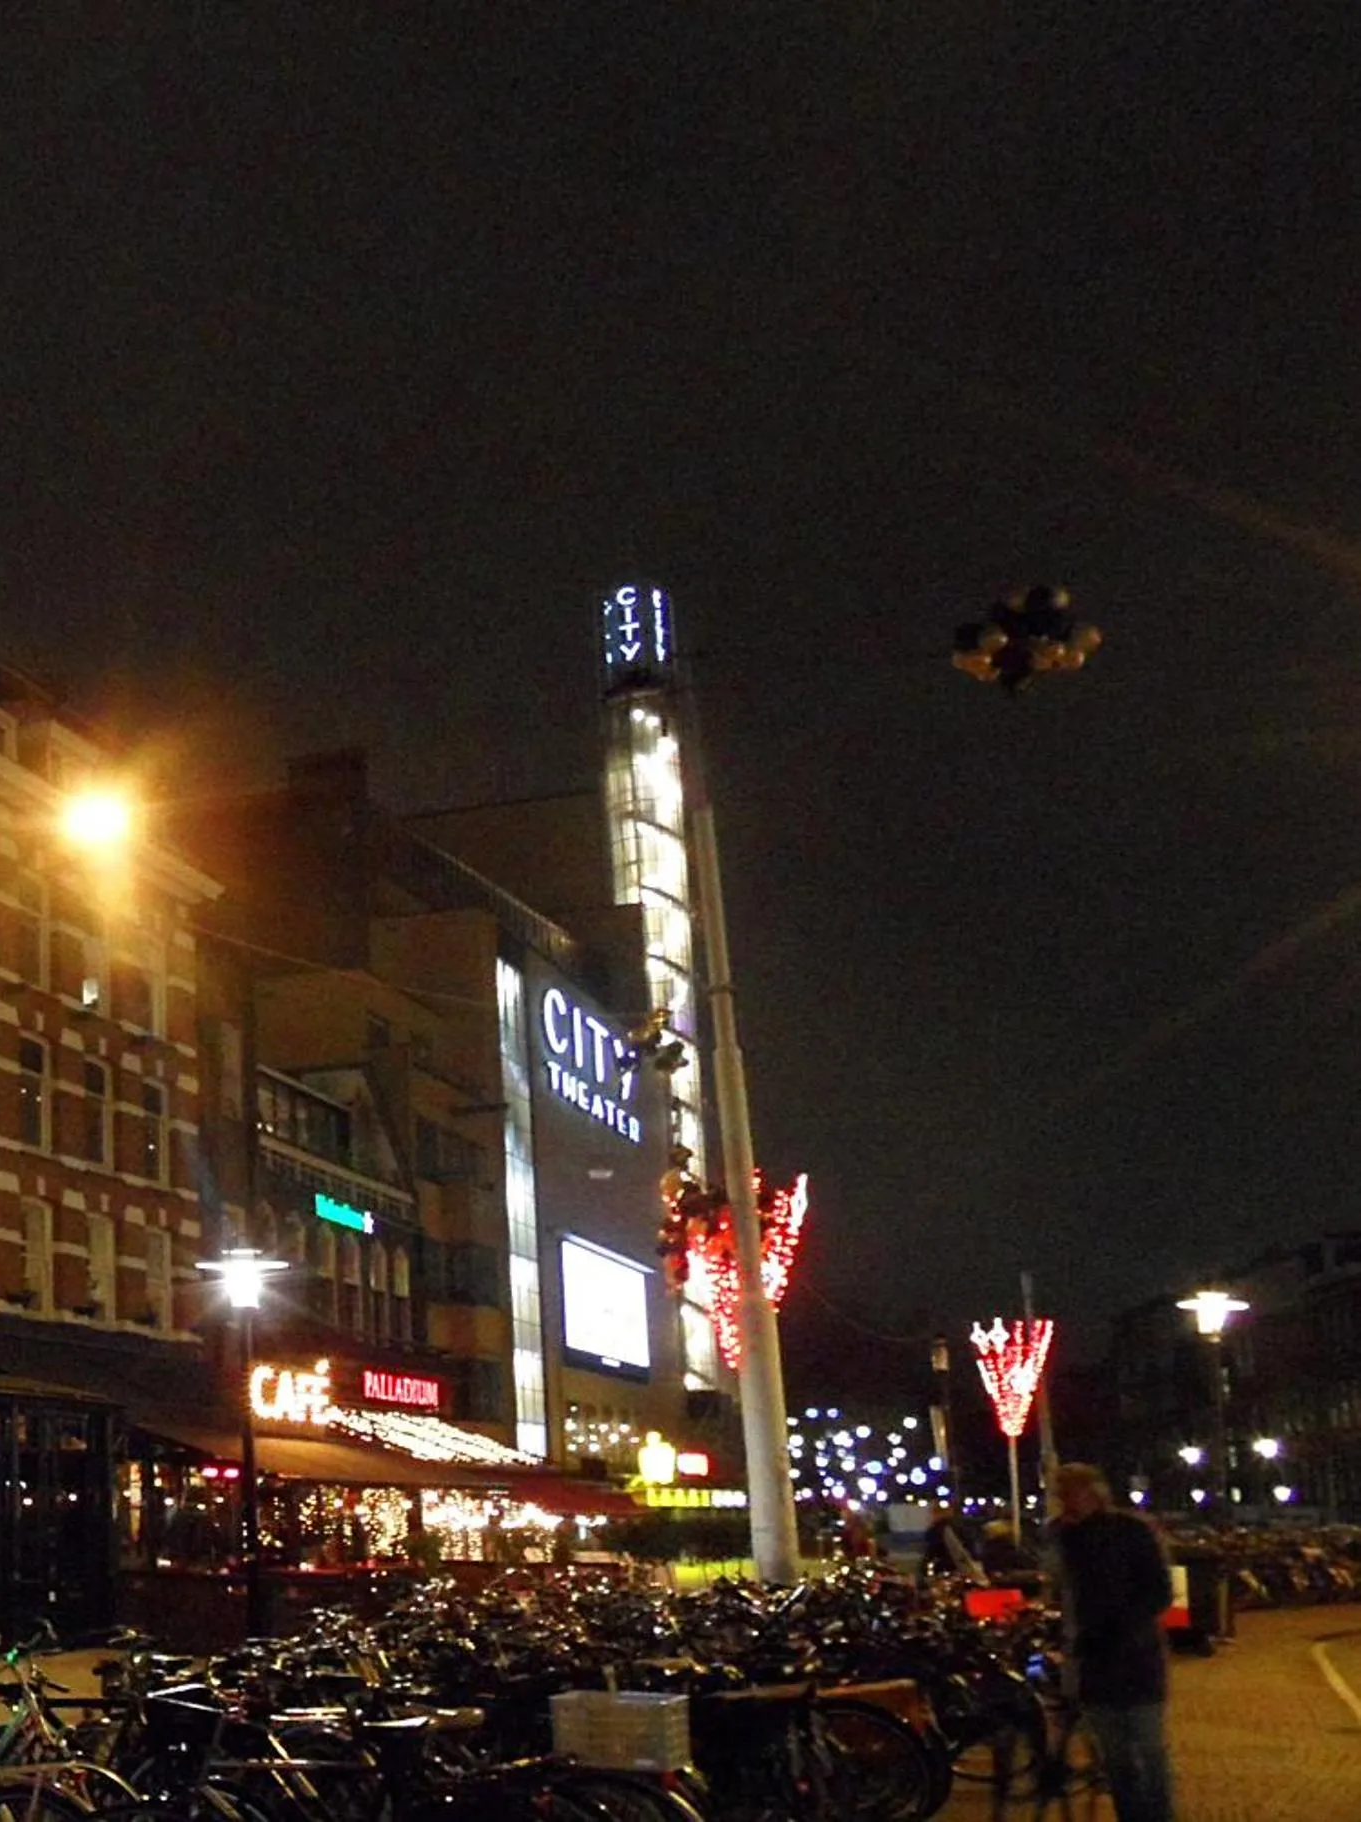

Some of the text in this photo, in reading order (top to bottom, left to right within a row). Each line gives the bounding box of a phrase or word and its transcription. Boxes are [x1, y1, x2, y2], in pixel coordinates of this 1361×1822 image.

[615, 586, 641, 662] CITY
[547, 1060, 641, 1143] THEATER
[363, 1369, 440, 1407] PALLADIUM
